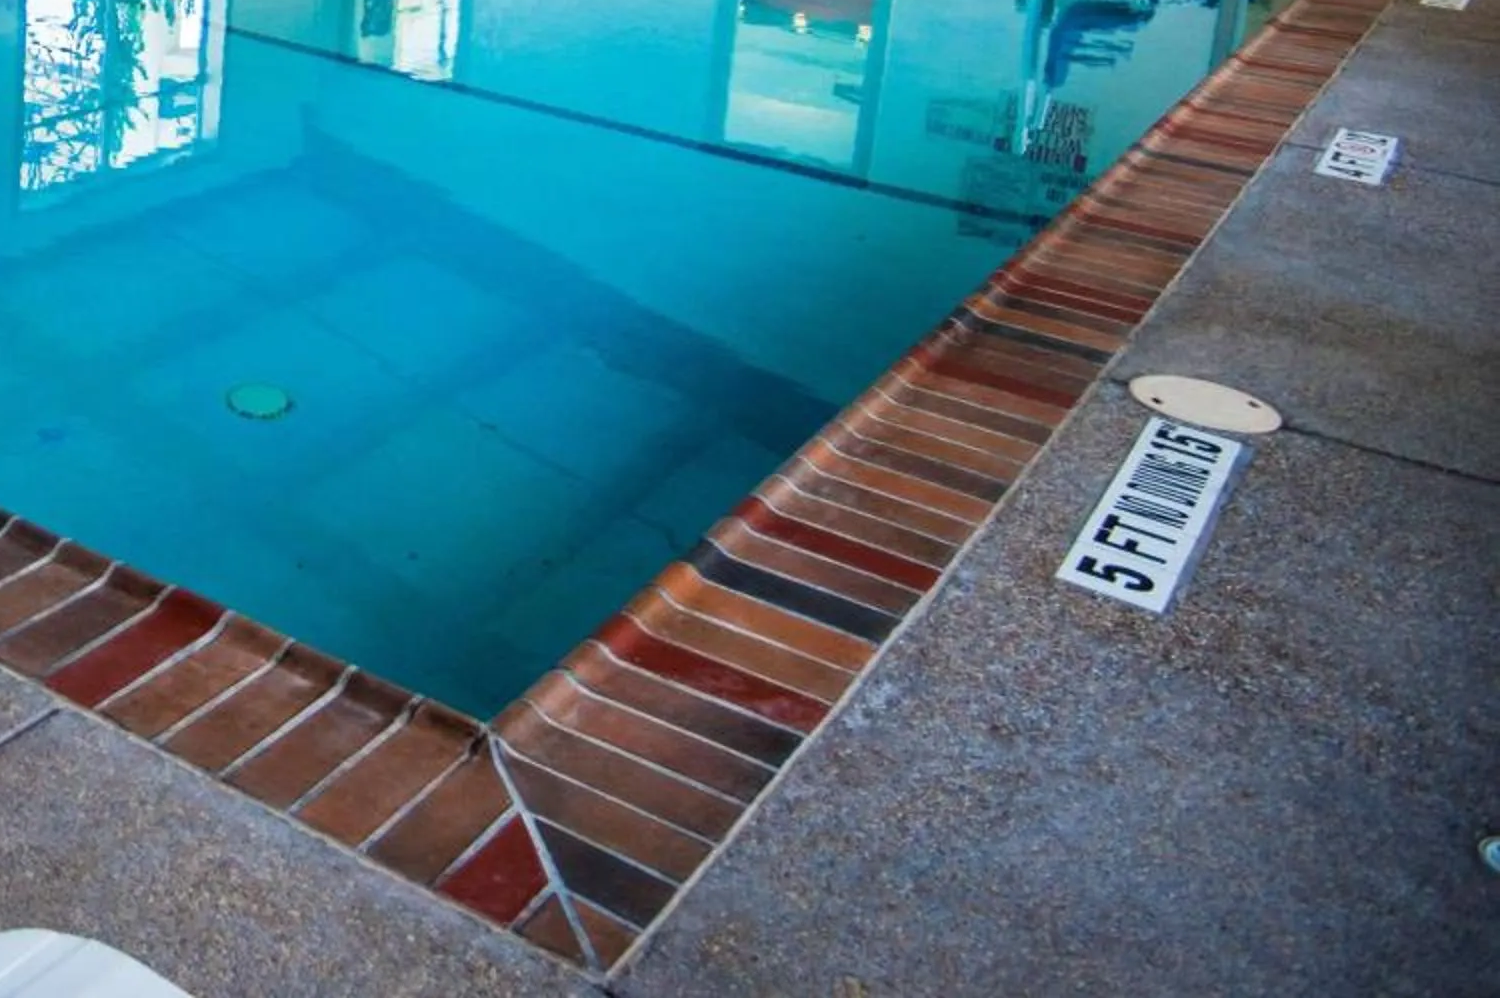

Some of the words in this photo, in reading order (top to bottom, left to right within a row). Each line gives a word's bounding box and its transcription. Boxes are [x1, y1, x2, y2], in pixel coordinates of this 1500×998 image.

[1125, 452, 1212, 508] DIVING
[1113, 493, 1190, 530] NO
[1092, 513, 1178, 566] FT
[1075, 555, 1155, 593] 5
